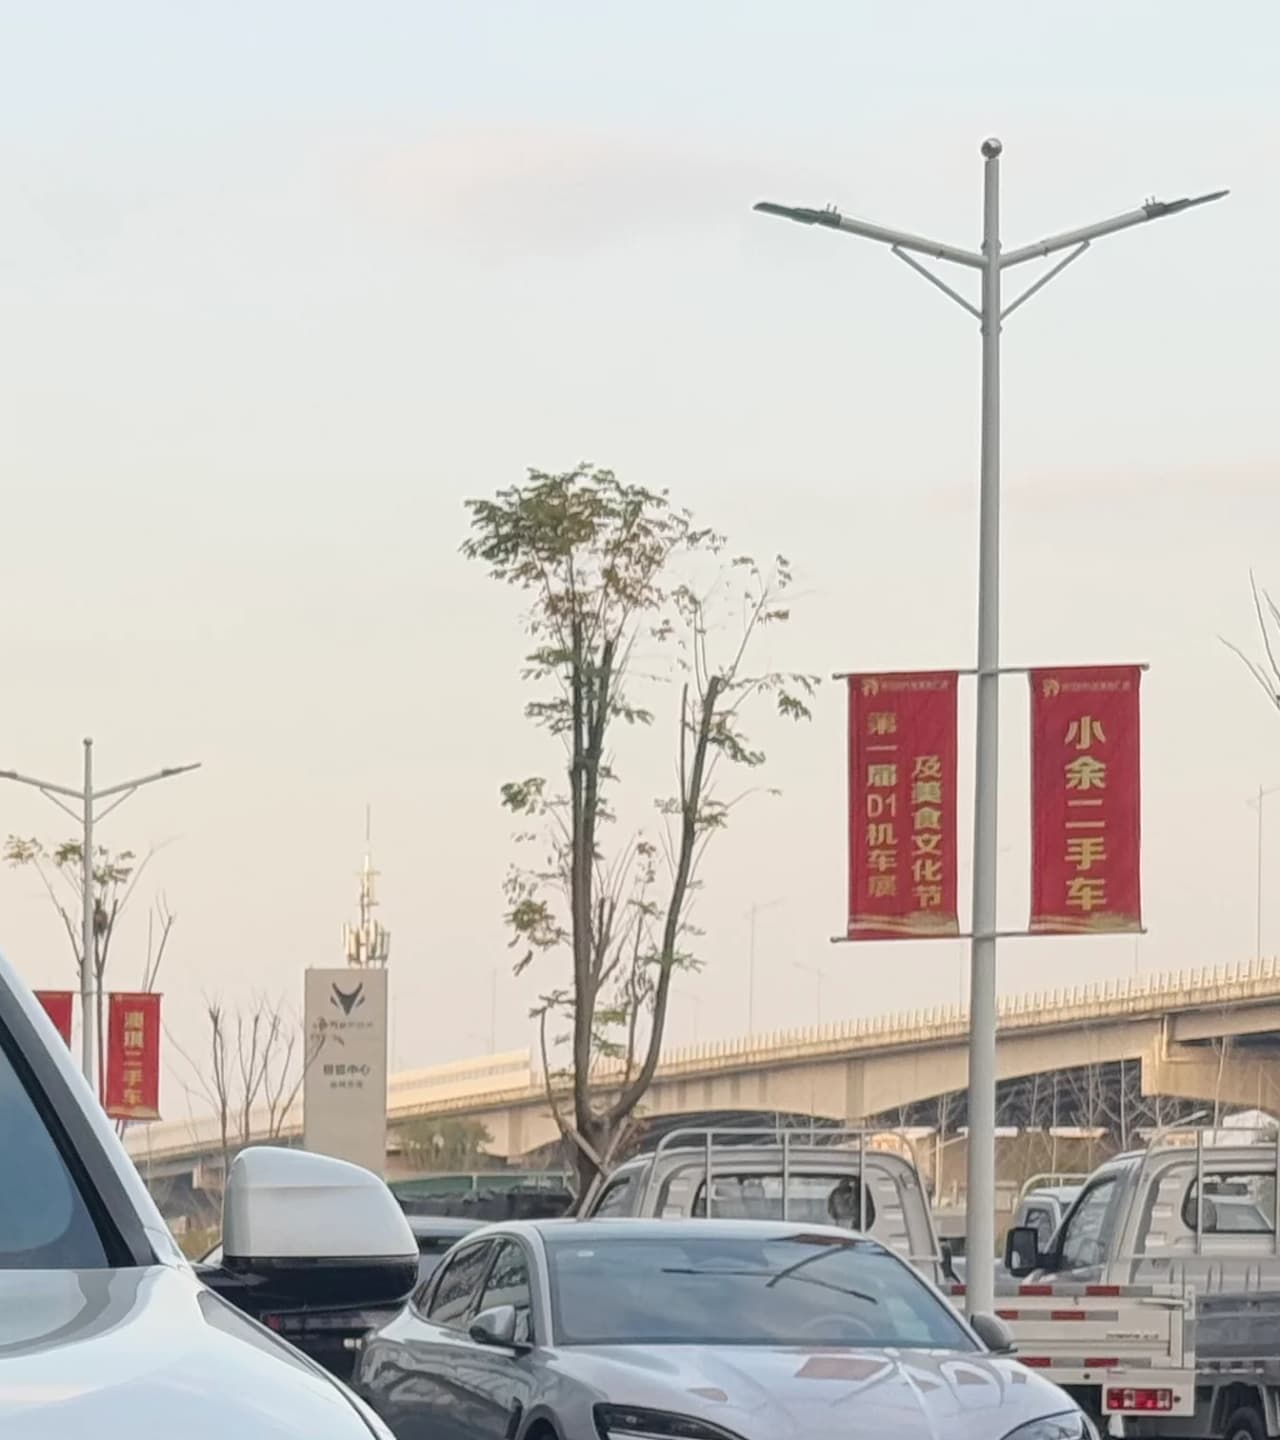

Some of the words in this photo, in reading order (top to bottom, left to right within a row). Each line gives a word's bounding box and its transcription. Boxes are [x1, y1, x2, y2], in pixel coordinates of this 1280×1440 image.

[866, 711, 899, 899] 第一届D1机车展
[911, 754, 943, 908] 及美食文化节
[1064, 715, 1107, 911] 小余二手车
